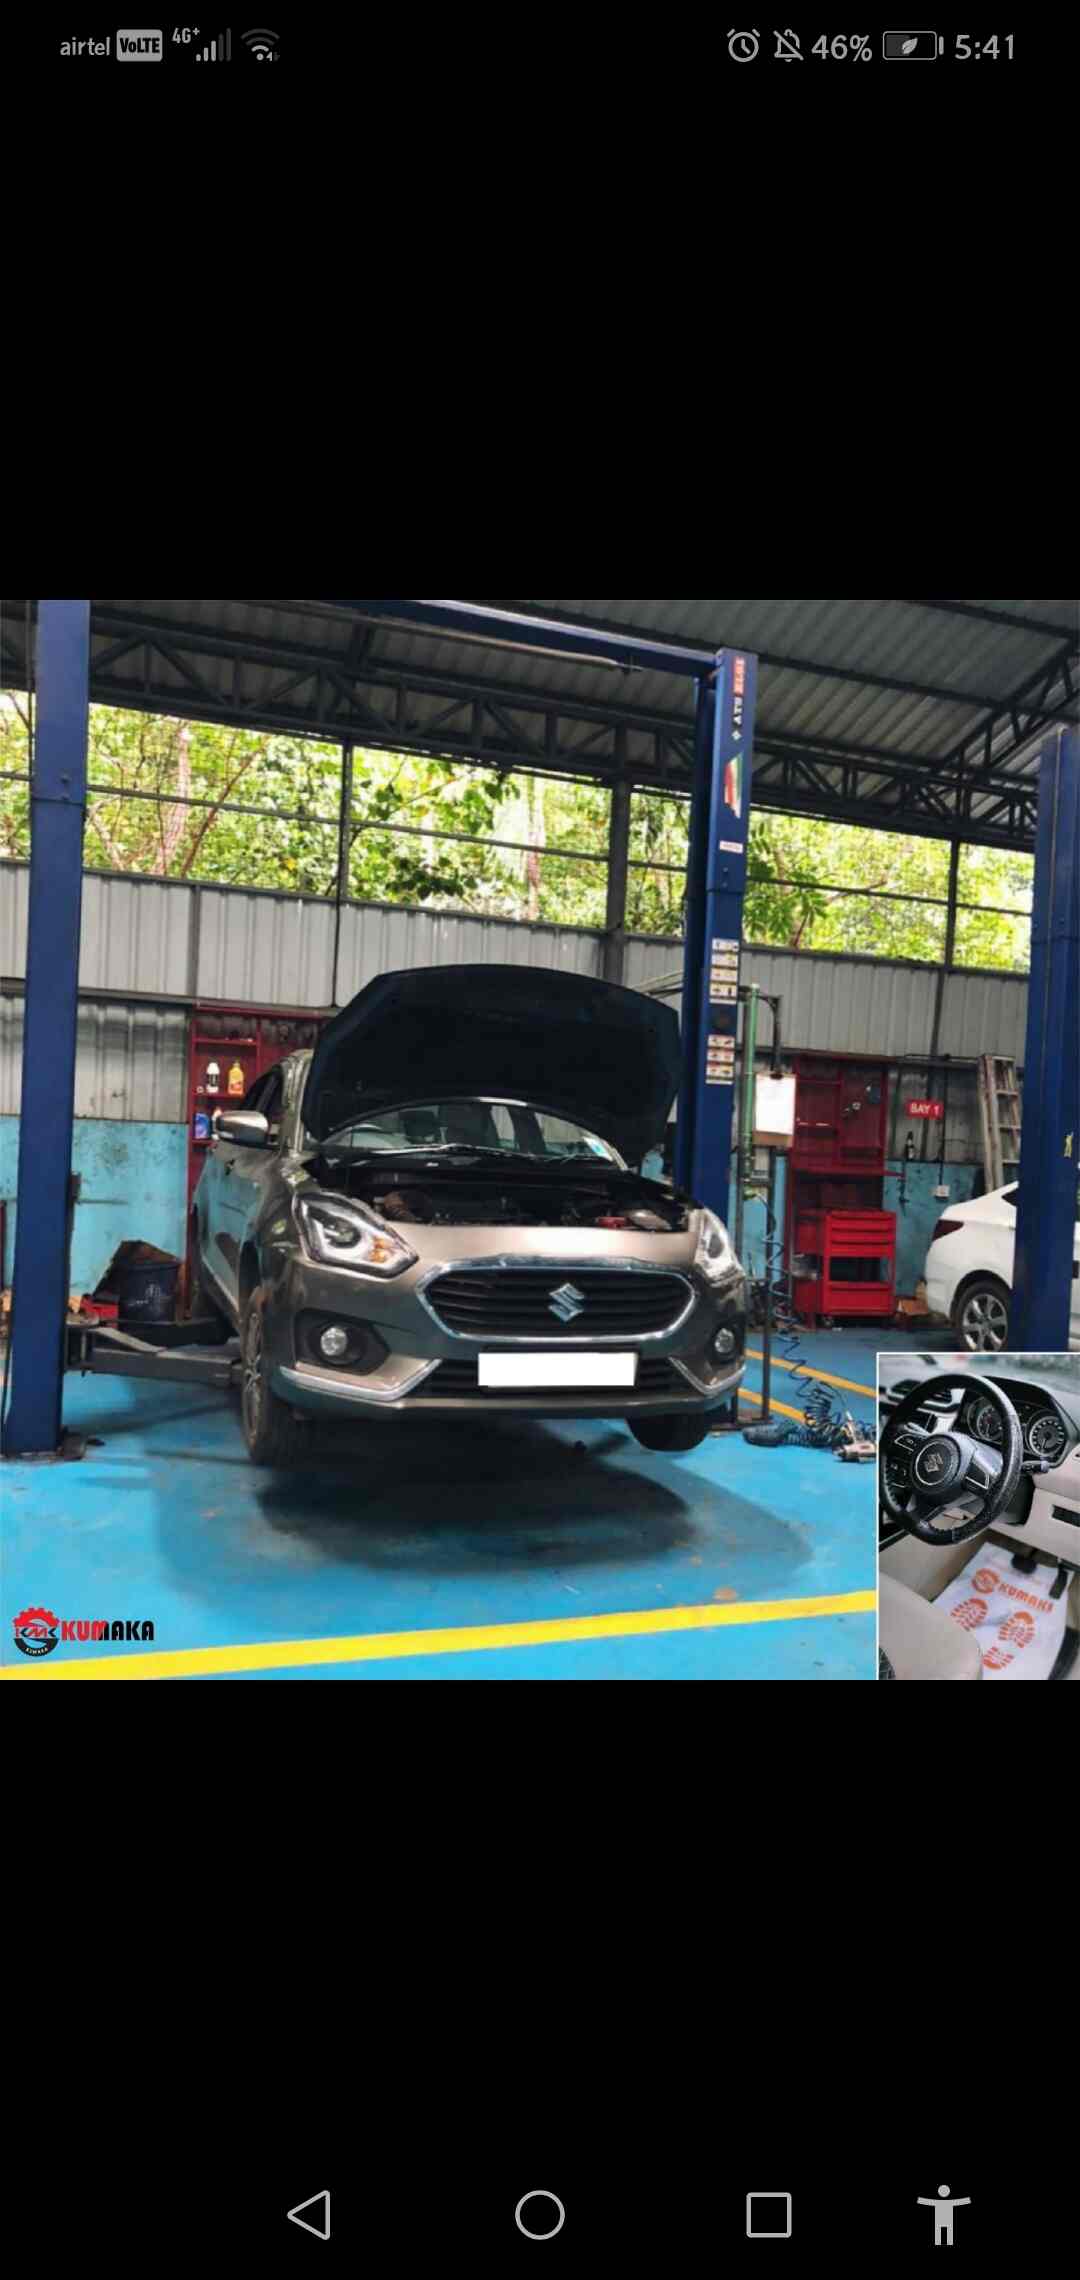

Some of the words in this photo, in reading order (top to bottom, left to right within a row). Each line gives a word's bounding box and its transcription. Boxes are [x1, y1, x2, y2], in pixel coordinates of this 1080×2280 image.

[60, 37, 110, 55] airtel
[120, 38, 160, 53] VoLTE
[173, 28, 199, 43] 4G+
[812, 35, 872, 61] 46%
[955, 35, 1013, 59] 5:41
